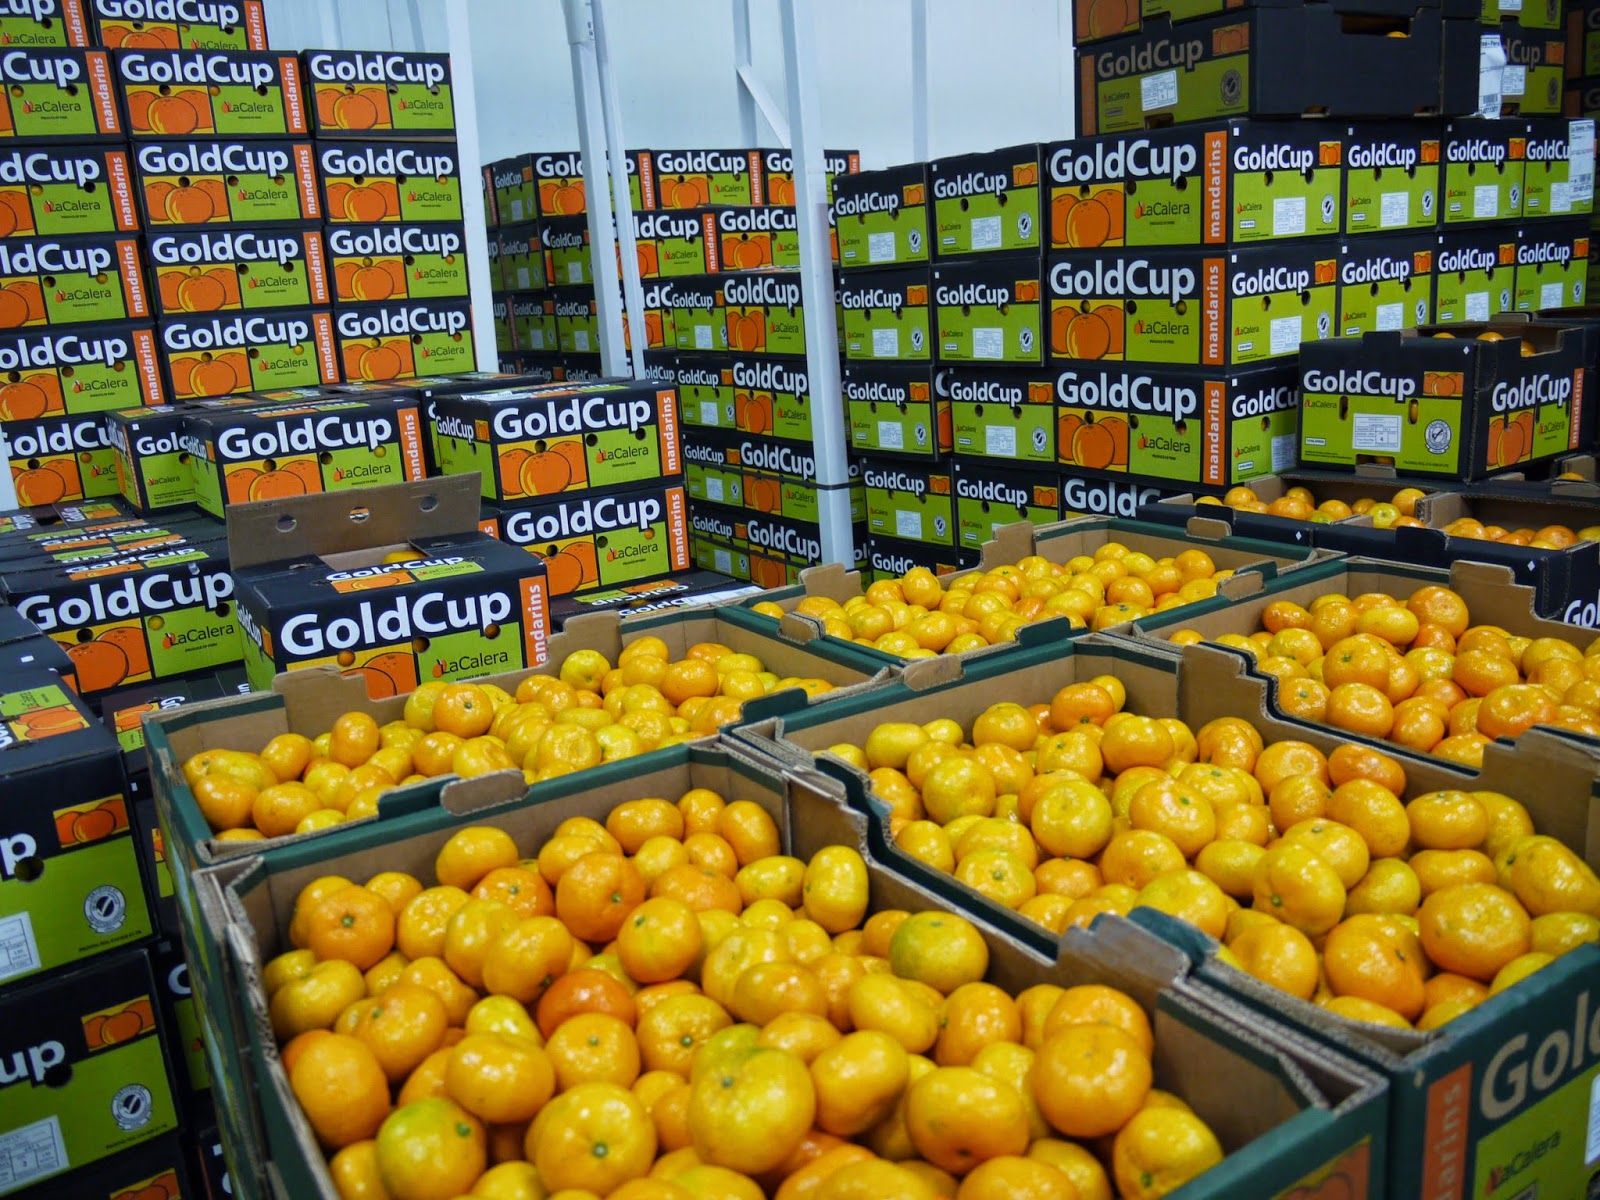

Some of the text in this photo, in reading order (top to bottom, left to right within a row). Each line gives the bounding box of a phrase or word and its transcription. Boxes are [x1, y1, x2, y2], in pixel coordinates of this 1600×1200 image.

[97, 0, 239, 30] GoldCup
[121, 53, 273, 91] GoldCup
[311, 54, 444, 89] GoldCup
[1097, 39, 1204, 79] GoldCup
[94, 57, 115, 129] mandarins
[285, 62, 301, 129] mandarins
[403, 98, 444, 110] LaCalera
[30, 101, 81, 114] LaCalera
[227, 102, 274, 113] LaCalera
[139, 143, 288, 177] GoldCup
[322, 148, 453, 177] GoldCup
[657, 151, 746, 175] GoldCup
[1050, 139, 1196, 182] GoldCup
[1233, 144, 1314, 174] GoldCup
[1348, 142, 1416, 170] GoldCup
[1447, 139, 1505, 166] GoldCup
[112, 156, 134, 226] mandarins
[243, 189, 288, 201] LaCalera
[300, 150, 317, 214] mandarins
[934, 172, 1008, 198] GoldCup
[1208, 140, 1222, 237] mandarins
[49, 200, 100, 212] LaCalera
[412, 191, 452, 202] LaCalera
[836, 192, 899, 217] GoldCup
[1141, 201, 1190, 216] LaCalera
[153, 233, 299, 265] GoldCup
[330, 228, 460, 258] GoldCup
[549, 233, 583, 249] GoldCup
[706, 217, 717, 271] mandarins
[1517, 242, 1570, 264] GoldCup
[309, 237, 325, 300] mandarins
[418, 268, 458, 279] LaCalera
[1341, 257, 1410, 282] GoldCup
[1438, 248, 1495, 272] GoldCup
[124, 246, 144, 313] mandarins
[255, 276, 298, 289] LaCalera
[724, 276, 800, 309] GoldCup
[1050, 258, 1196, 304] GoldCup
[1232, 267, 1310, 293] GoldCup
[61, 287, 112, 301] LaCalera
[672, 291, 714, 313] GoldCup
[842, 289, 903, 312] GoldCup
[936, 284, 1009, 310] GoldCup
[337, 307, 466, 335] GoldCup
[555, 302, 589, 320] GoldCup
[1207, 265, 1219, 359] mandarins
[164, 318, 308, 347] GoldCup
[1139, 321, 1189, 335] LaCalera
[319, 318, 335, 380] mandarins
[425, 347, 465, 358] LaCalera
[140, 335, 160, 400] mandarins
[265, 359, 308, 371] LaCalera
[677, 369, 719, 389] GoldCup
[733, 361, 808, 397] GoldCup
[80, 378, 128, 392] LaCalera
[847, 382, 906, 406] GoldCup
[950, 381, 1023, 407] GoldCup
[1057, 371, 1197, 422] GoldCup
[1303, 369, 1416, 401] GoldCup
[1492, 374, 1571, 411] GoldCup
[436, 415, 475, 444] GoldCup
[494, 398, 651, 439] GoldCup
[218, 416, 392, 459] GoldCup
[657, 396, 676, 471] mandarins
[1143, 435, 1191, 454] LaCalera
[1207, 389, 1220, 480] mandarins
[602, 445, 649, 461] LaCalera
[684, 444, 725, 465] GoldCup
[740, 441, 815, 479] GoldCup
[340, 463, 392, 479] LaCalera
[864, 470, 925, 495] GoldCup
[956, 479, 1028, 507] GoldCup
[506, 498, 661, 543] GoldCup
[670, 493, 686, 567] mandarins
[692, 515, 733, 538] GoldCup
[612, 542, 659, 560] LaCalera
[748, 520, 821, 562] GoldCup
[325, 556, 464, 582] GoldCup
[16, 571, 235, 631] GoldCup
[170, 623, 235, 646] LaCalera
[281, 591, 511, 656] GoldCup
[528, 583, 548, 668] andarins
[441, 649, 509, 674] LaCalera
